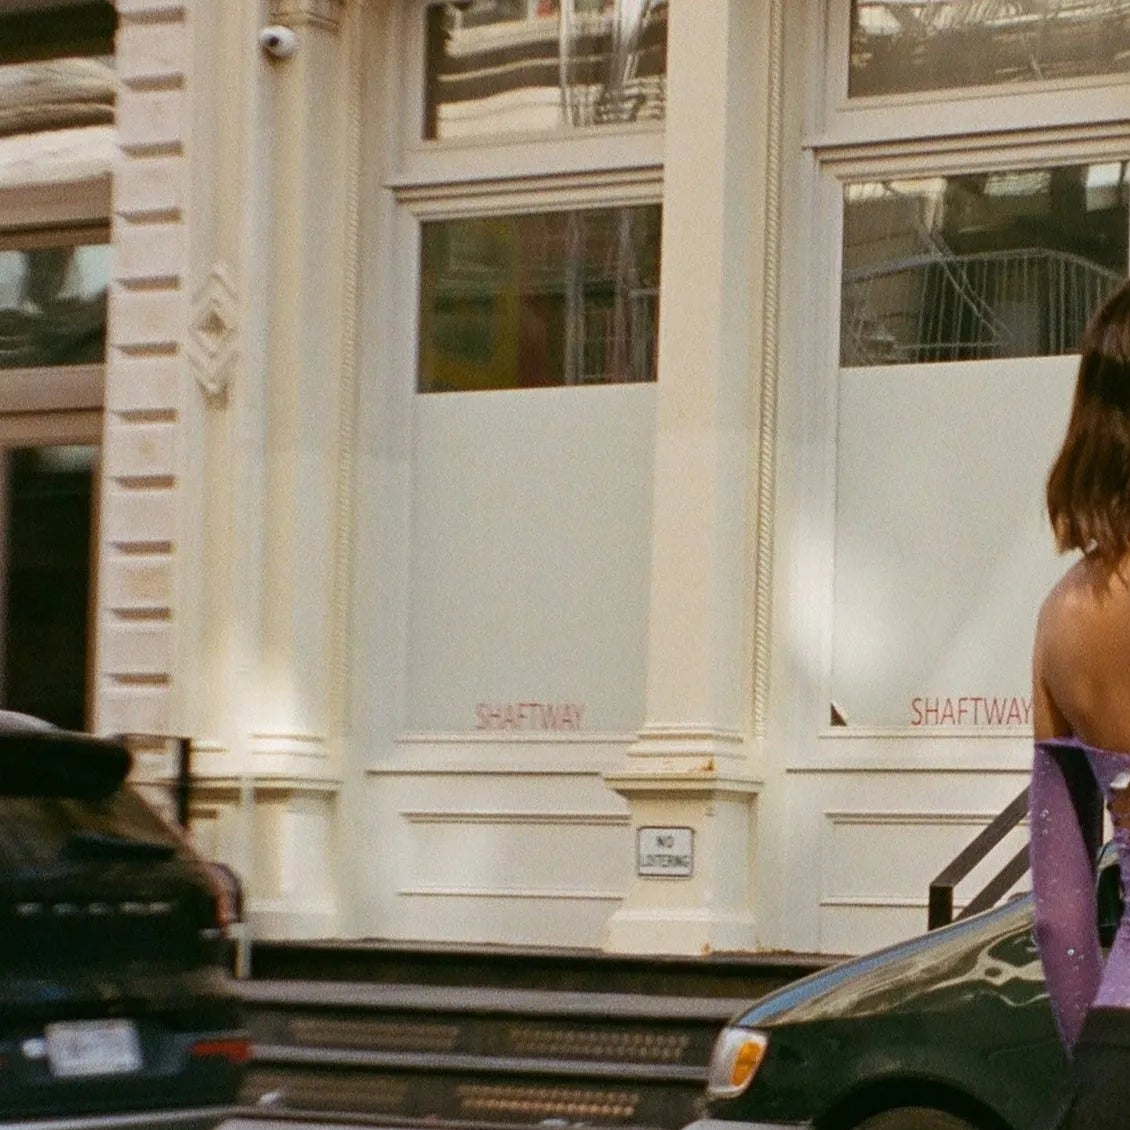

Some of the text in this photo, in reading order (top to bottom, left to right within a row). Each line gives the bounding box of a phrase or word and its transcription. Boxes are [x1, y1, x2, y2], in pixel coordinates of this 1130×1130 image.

[475, 702, 586, 731] SHAFTWAY
[911, 697, 1033, 726] SHAFTWAY
[655, 834, 675, 849] NO
[640, 853, 691, 868] LOITERING
